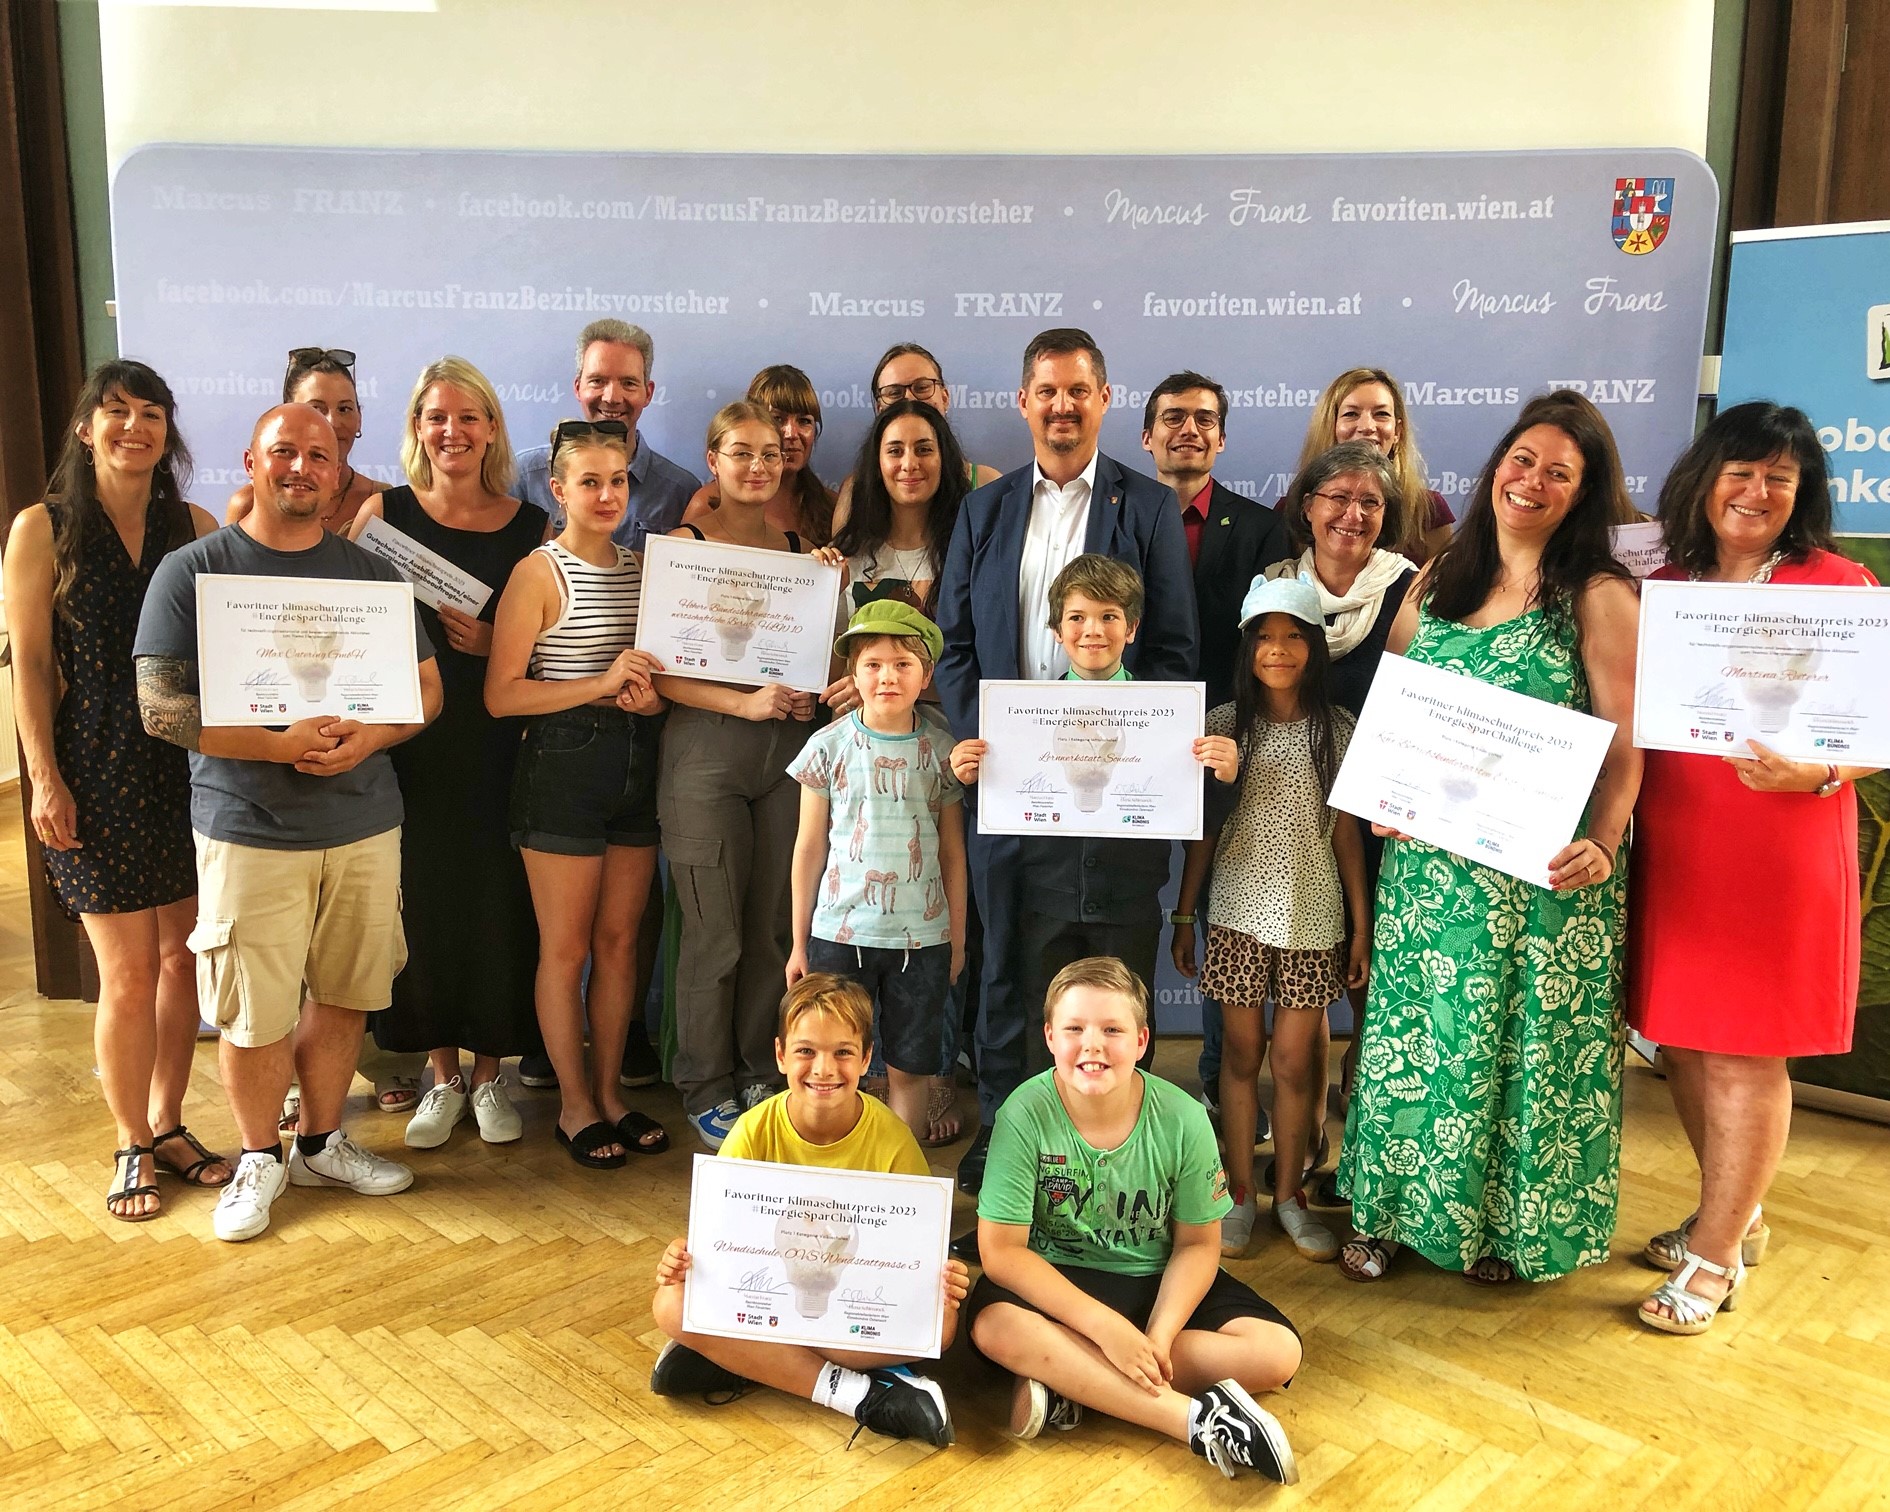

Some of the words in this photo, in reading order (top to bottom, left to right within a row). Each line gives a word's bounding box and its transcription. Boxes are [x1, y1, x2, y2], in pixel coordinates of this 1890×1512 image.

[152, 185, 271, 211] Marcus
[292, 189, 404, 215] FRANZ
[457, 191, 1034, 224] facebook.com/MarcusFranzBezirksvorsteher
[1104, 188, 1210, 229] Marcus
[1229, 187, 1312, 225] Franz
[1331, 195, 1554, 223] favoriten.wien.at
[156, 277, 730, 315] facebook.com/MarcusFranzBezirksvorsteher
[808, 291, 926, 317] Marcus
[954, 293, 1063, 318] FRANZ
[1142, 292, 1362, 317] favoriten.wien.at
[1453, 278, 1557, 320] Marcus
[1584, 275, 1668, 315] Franz
[1403, 382, 1520, 406] Marcus
[366, 532, 398, 556] Gutschein
[397, 552, 409, 563] zur
[408, 559, 444, 585] Ausbildung
[443, 582, 480, 607] eines/einer
[670, 560, 717, 574] Favoritner
[718, 566, 793, 585] Klimaschutzpreis
[794, 577, 816, 587] 2023
[226, 600, 279, 610] Favoritner
[282, 602, 364, 614] Klimaschutzpreis
[366, 605, 388, 614] 2023
[1675, 610, 1740, 622] Favoritner
[1744, 613, 1854, 628] Klimaschutzpreis
[1857, 617, 1888, 628] 2023
[1008, 706, 1060, 715] Favoritner
[1062, 706, 1148, 718] Klimaschutzpreis
[1150, 708, 1175, 718] 2023
[1032, 717, 1151, 729] #EnergieSparChallenge
[1400, 687, 1455, 712] Favoritner
[1456, 705, 1546, 742] Klimaschutzpreis
[1546, 735, 1574, 751] 2023
[724, 1188, 785, 1204] Favoritner
[788, 1194, 886, 1215] Klimaschutzpreis
[889, 1205, 917, 1217] 2023
[752, 1204, 888, 1226] #EnergieSparChallenge
[908, 1259, 921, 1271] 3
